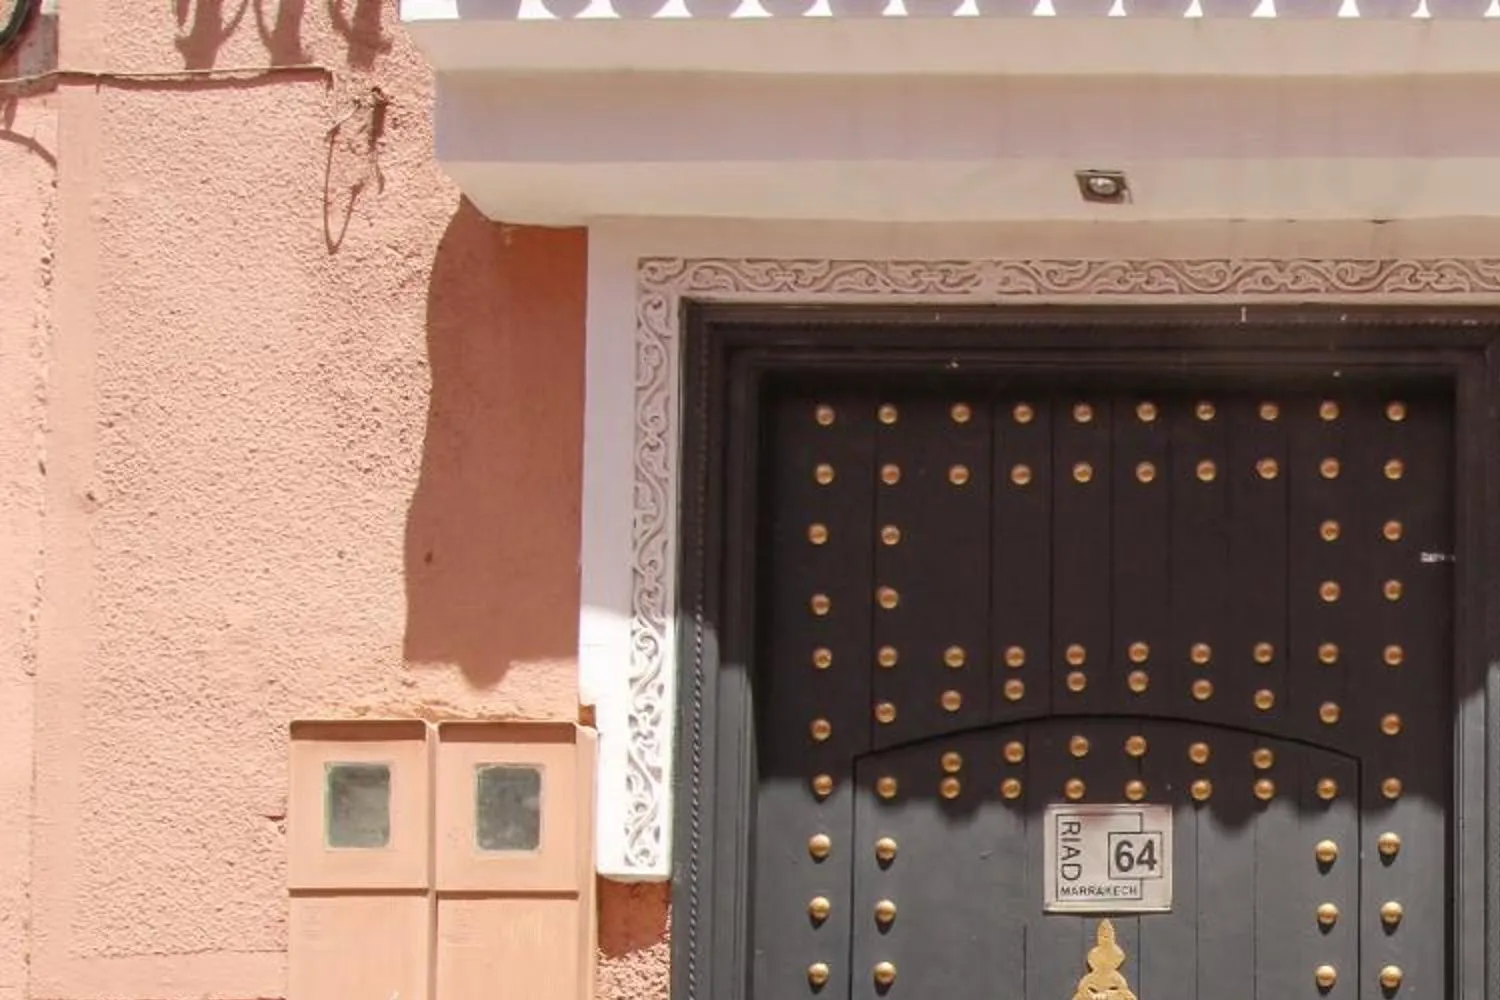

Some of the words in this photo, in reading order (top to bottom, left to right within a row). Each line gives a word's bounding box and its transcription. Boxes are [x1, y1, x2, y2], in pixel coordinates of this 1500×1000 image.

[1060, 821, 1082, 881] RIAD
[1115, 839, 1157, 873] 64
[1060, 885, 1137, 897] MARRAKECH
